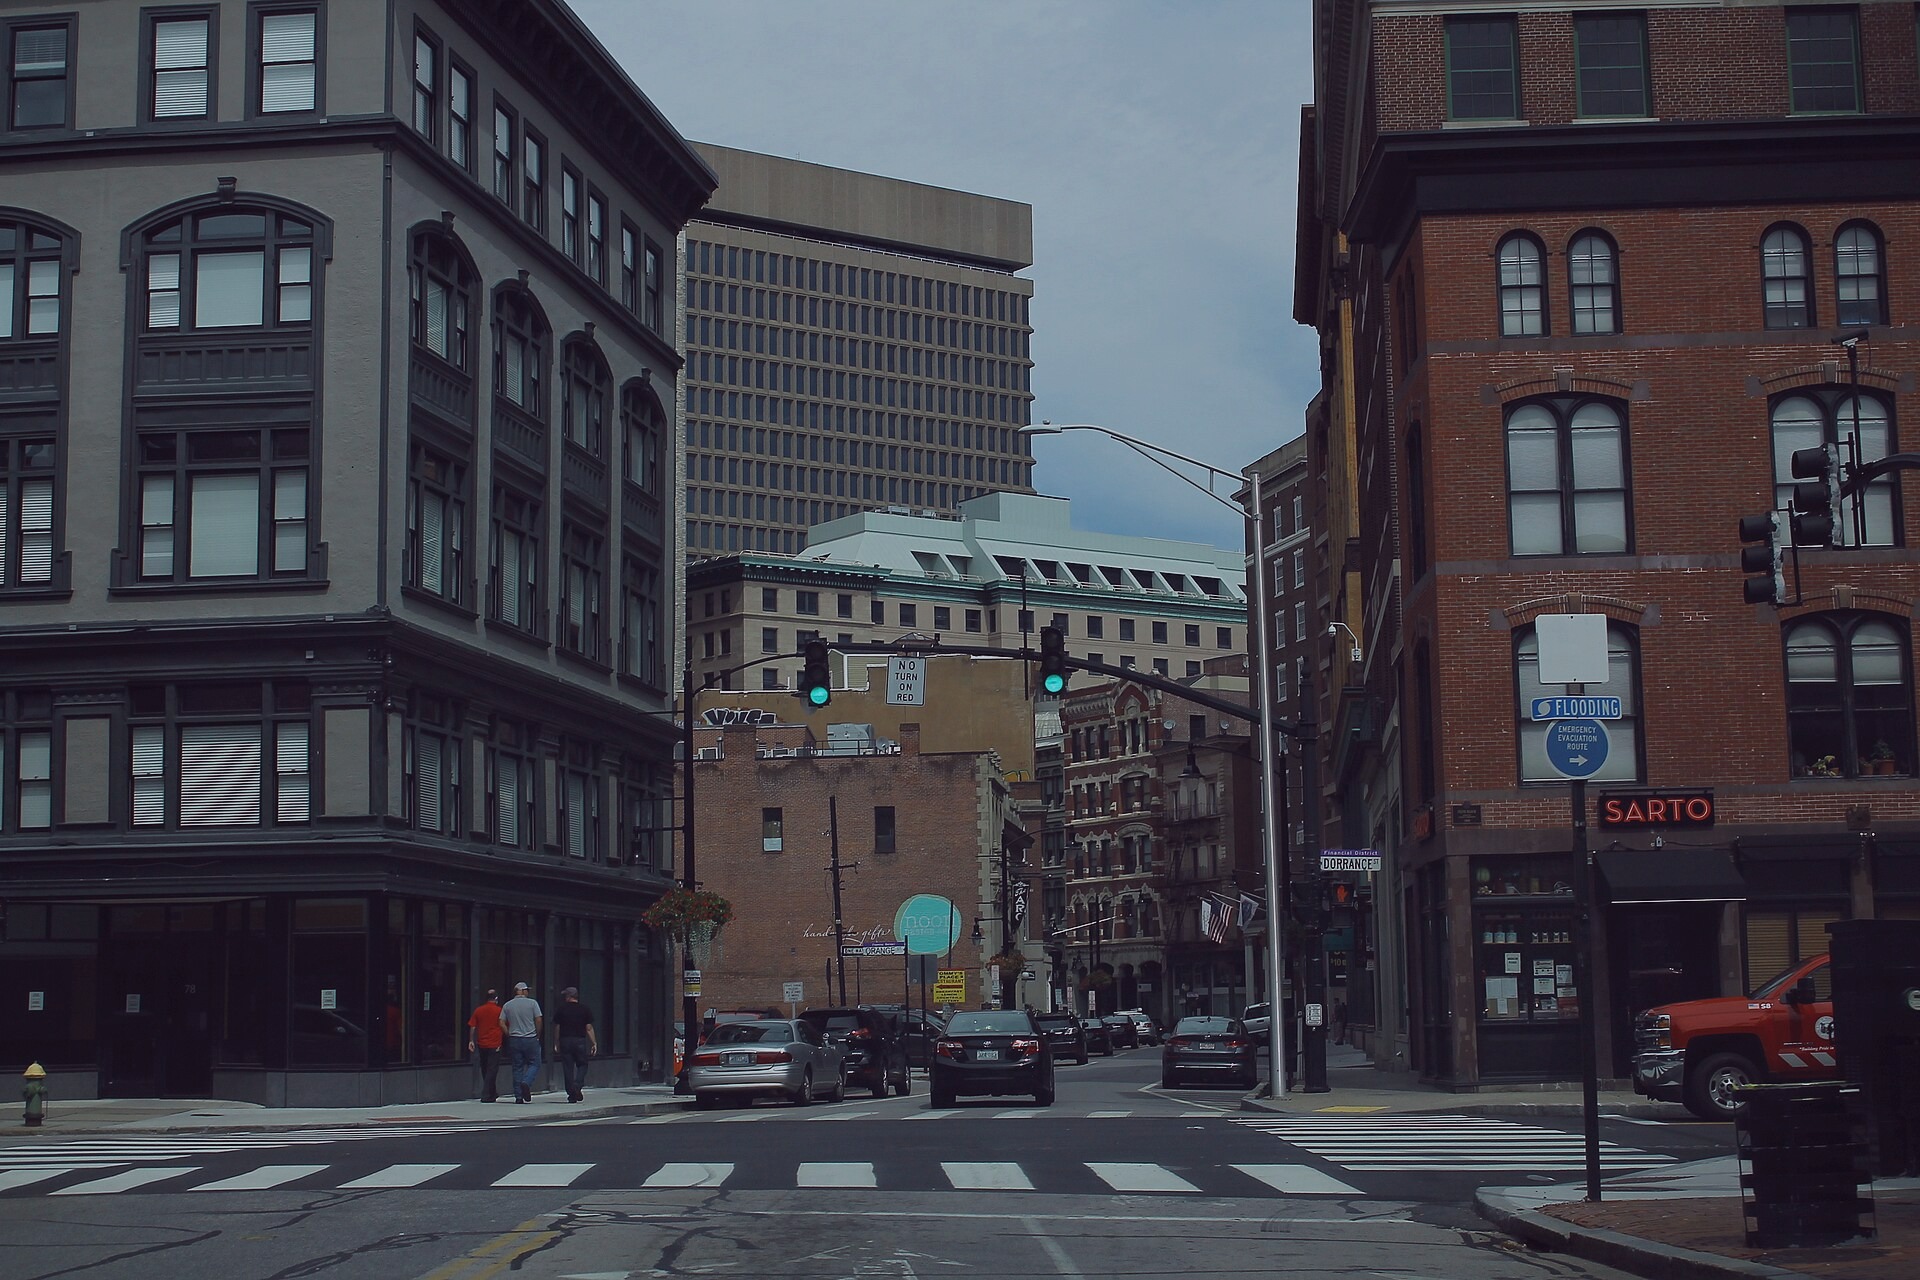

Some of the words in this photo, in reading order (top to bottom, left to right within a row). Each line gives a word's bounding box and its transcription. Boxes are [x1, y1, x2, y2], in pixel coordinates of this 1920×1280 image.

[899, 661, 915, 670] NO
[1555, 699, 1618, 716] FLOODING
[1558, 725, 1596, 734] EMERGENCY
[1558, 734, 1597, 742] EVACUATION
[1605, 797, 1711, 823] SARTO
[1323, 858, 1373, 870] DORRANCE
[865, 947, 895, 955] ORANGE
[184, 984, 196, 994] 78
